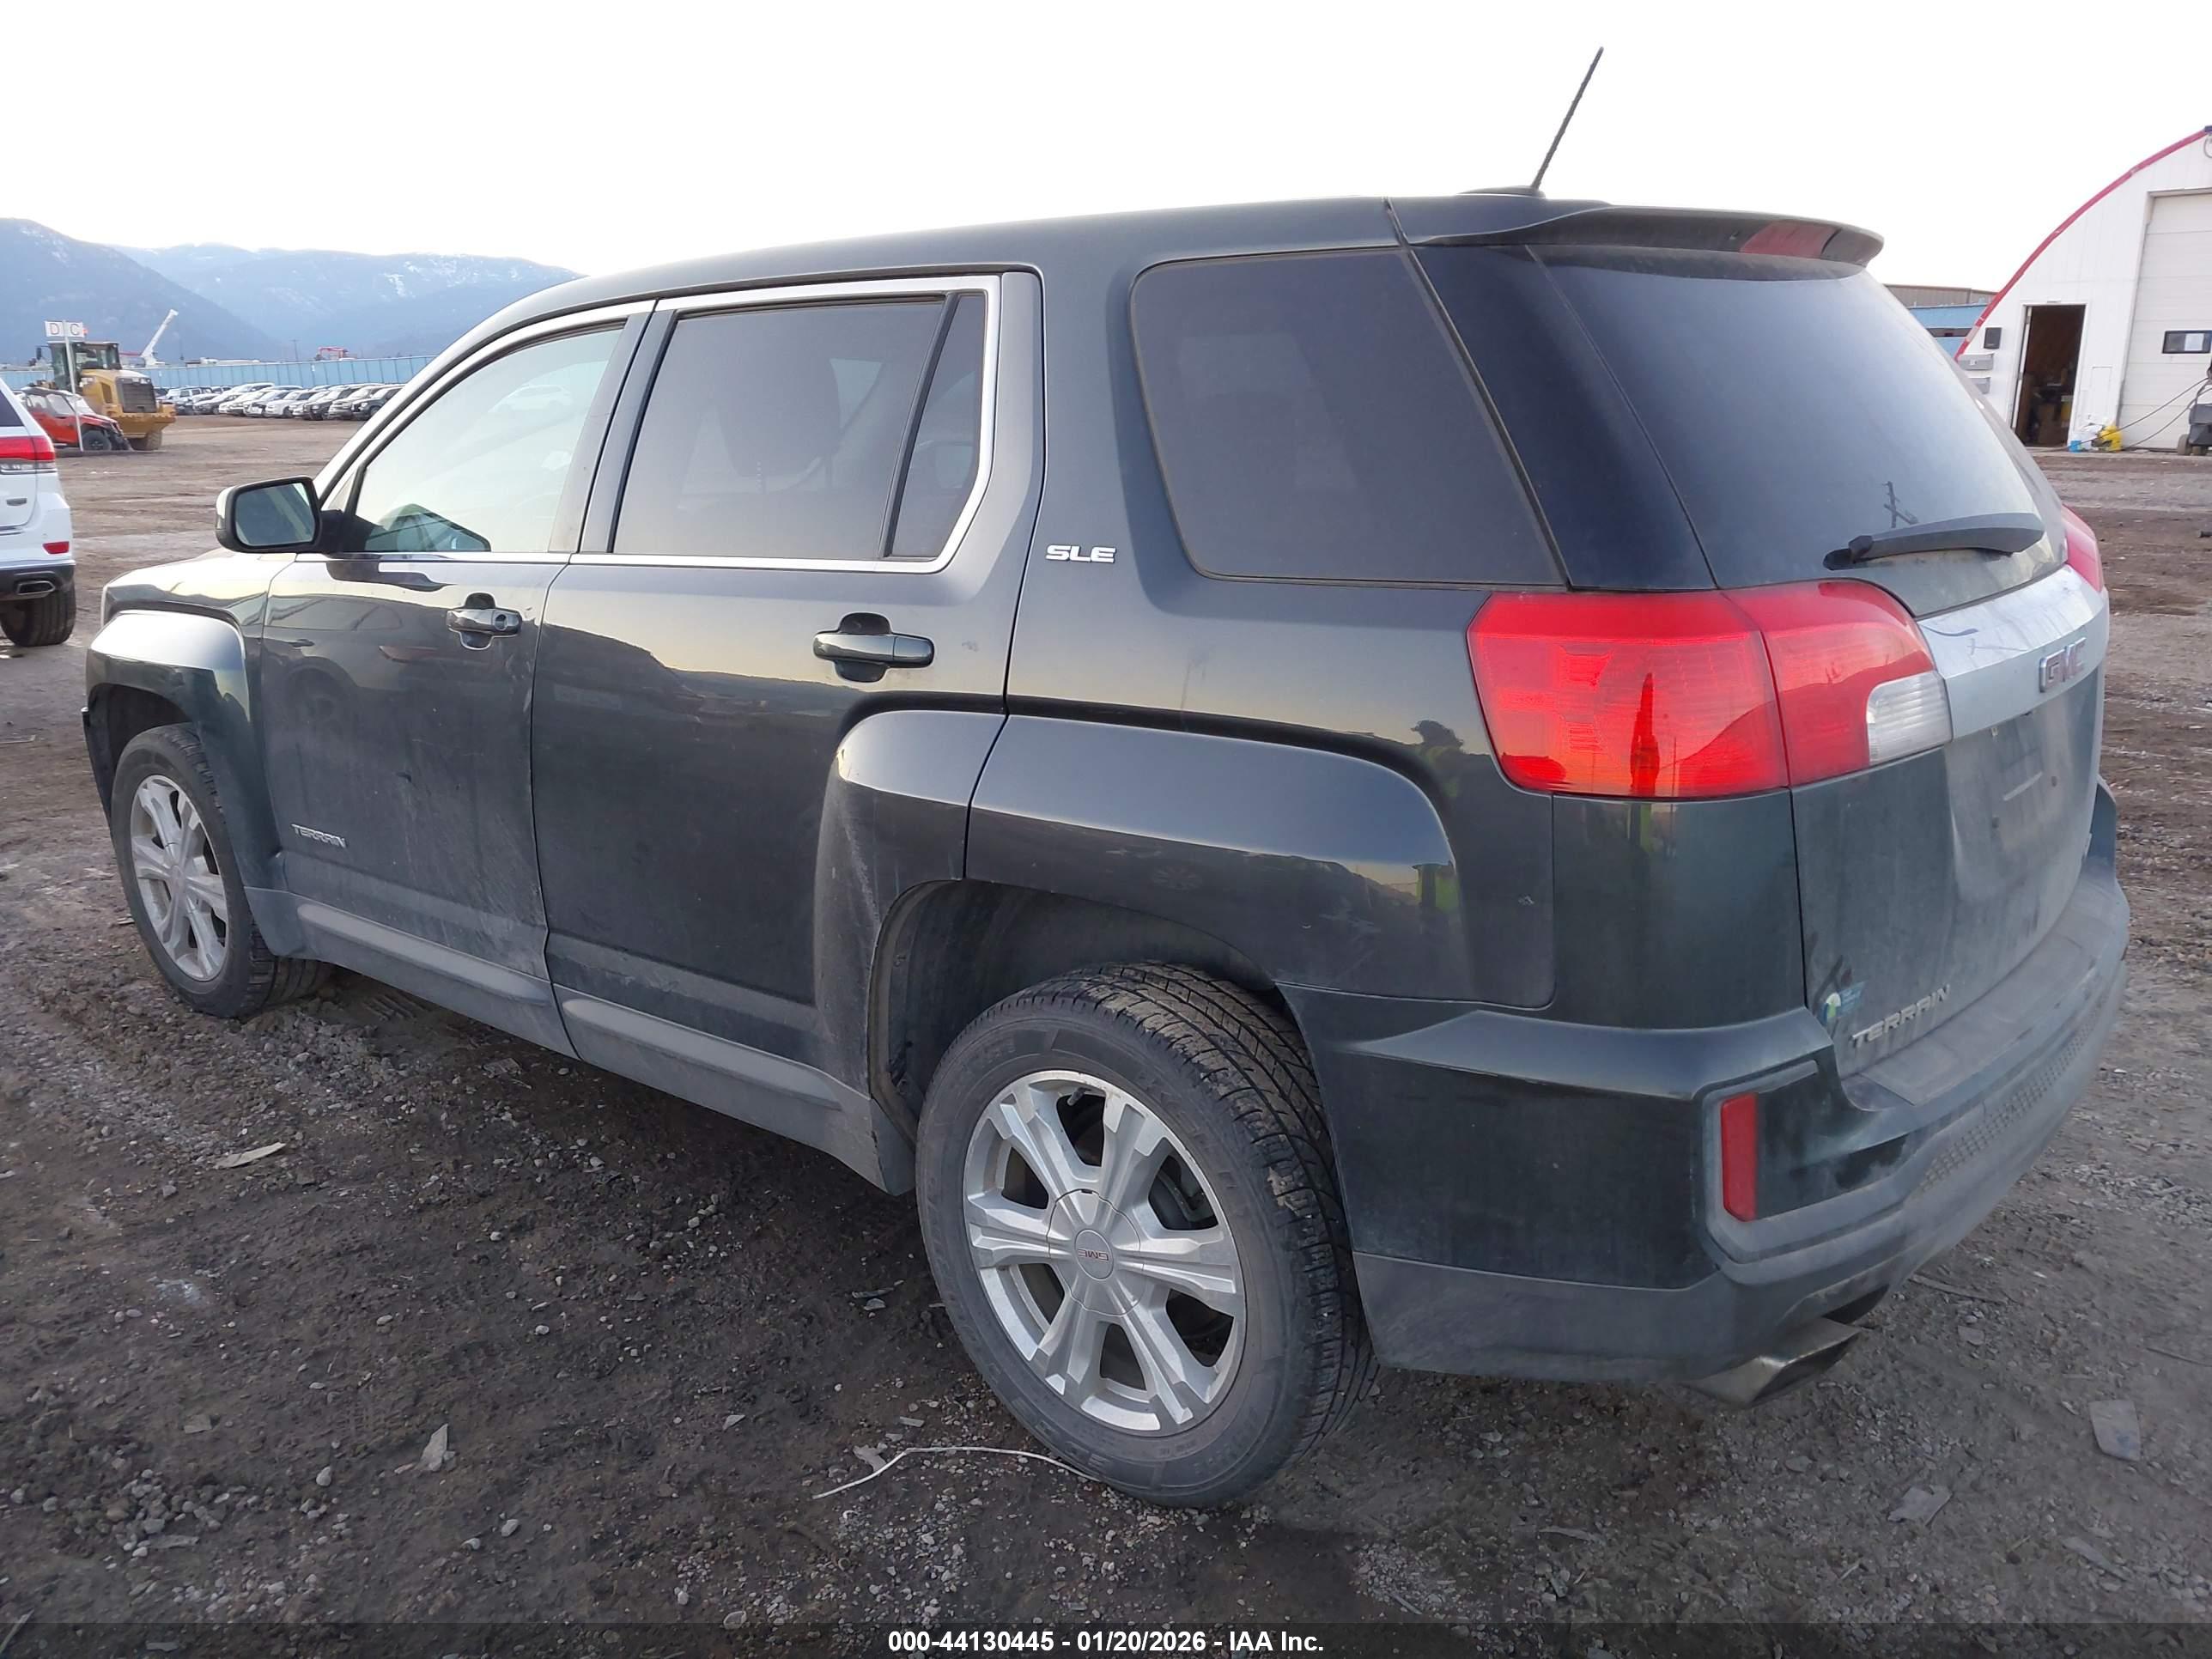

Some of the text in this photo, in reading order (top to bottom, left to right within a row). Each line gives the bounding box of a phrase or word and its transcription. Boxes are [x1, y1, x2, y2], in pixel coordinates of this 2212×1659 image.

[50, 323, 80, 336] D C
[1046, 544, 1116, 563] SLE
[2039, 637, 2087, 694] GMC
[1851, 983, 1950, 1048] TERRAIN
[1078, 1248, 1110, 1263] GMC
